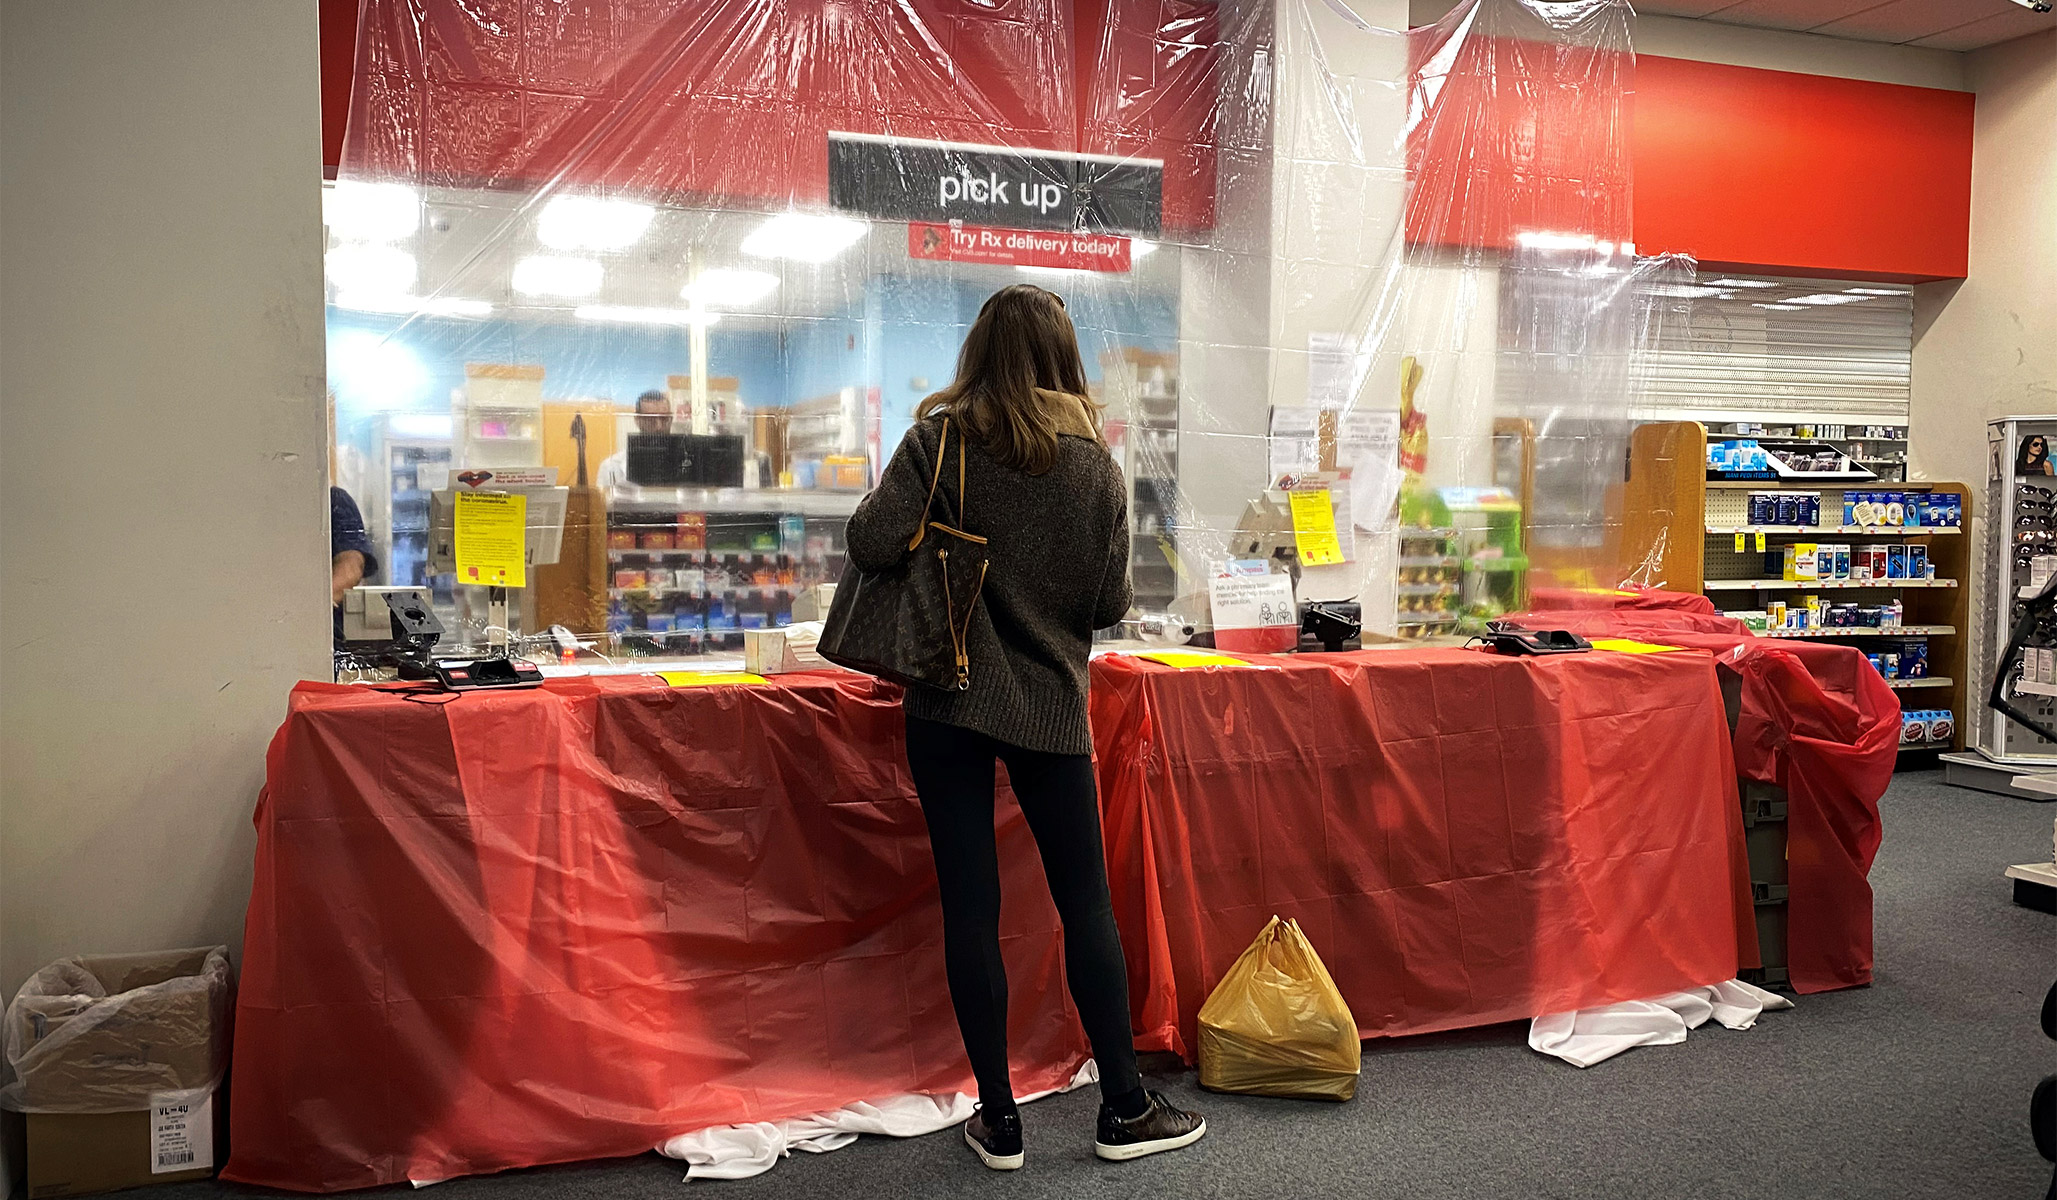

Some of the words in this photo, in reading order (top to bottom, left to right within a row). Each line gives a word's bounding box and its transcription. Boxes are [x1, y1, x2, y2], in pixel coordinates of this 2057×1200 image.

[940, 172, 1009, 207] pick
[1020, 182, 1061, 215] up
[950, 228, 977, 249] Try
[981, 231, 1002, 248] Rx
[1006, 233, 1068, 255] delivery
[1072, 239, 1121, 258] today!
